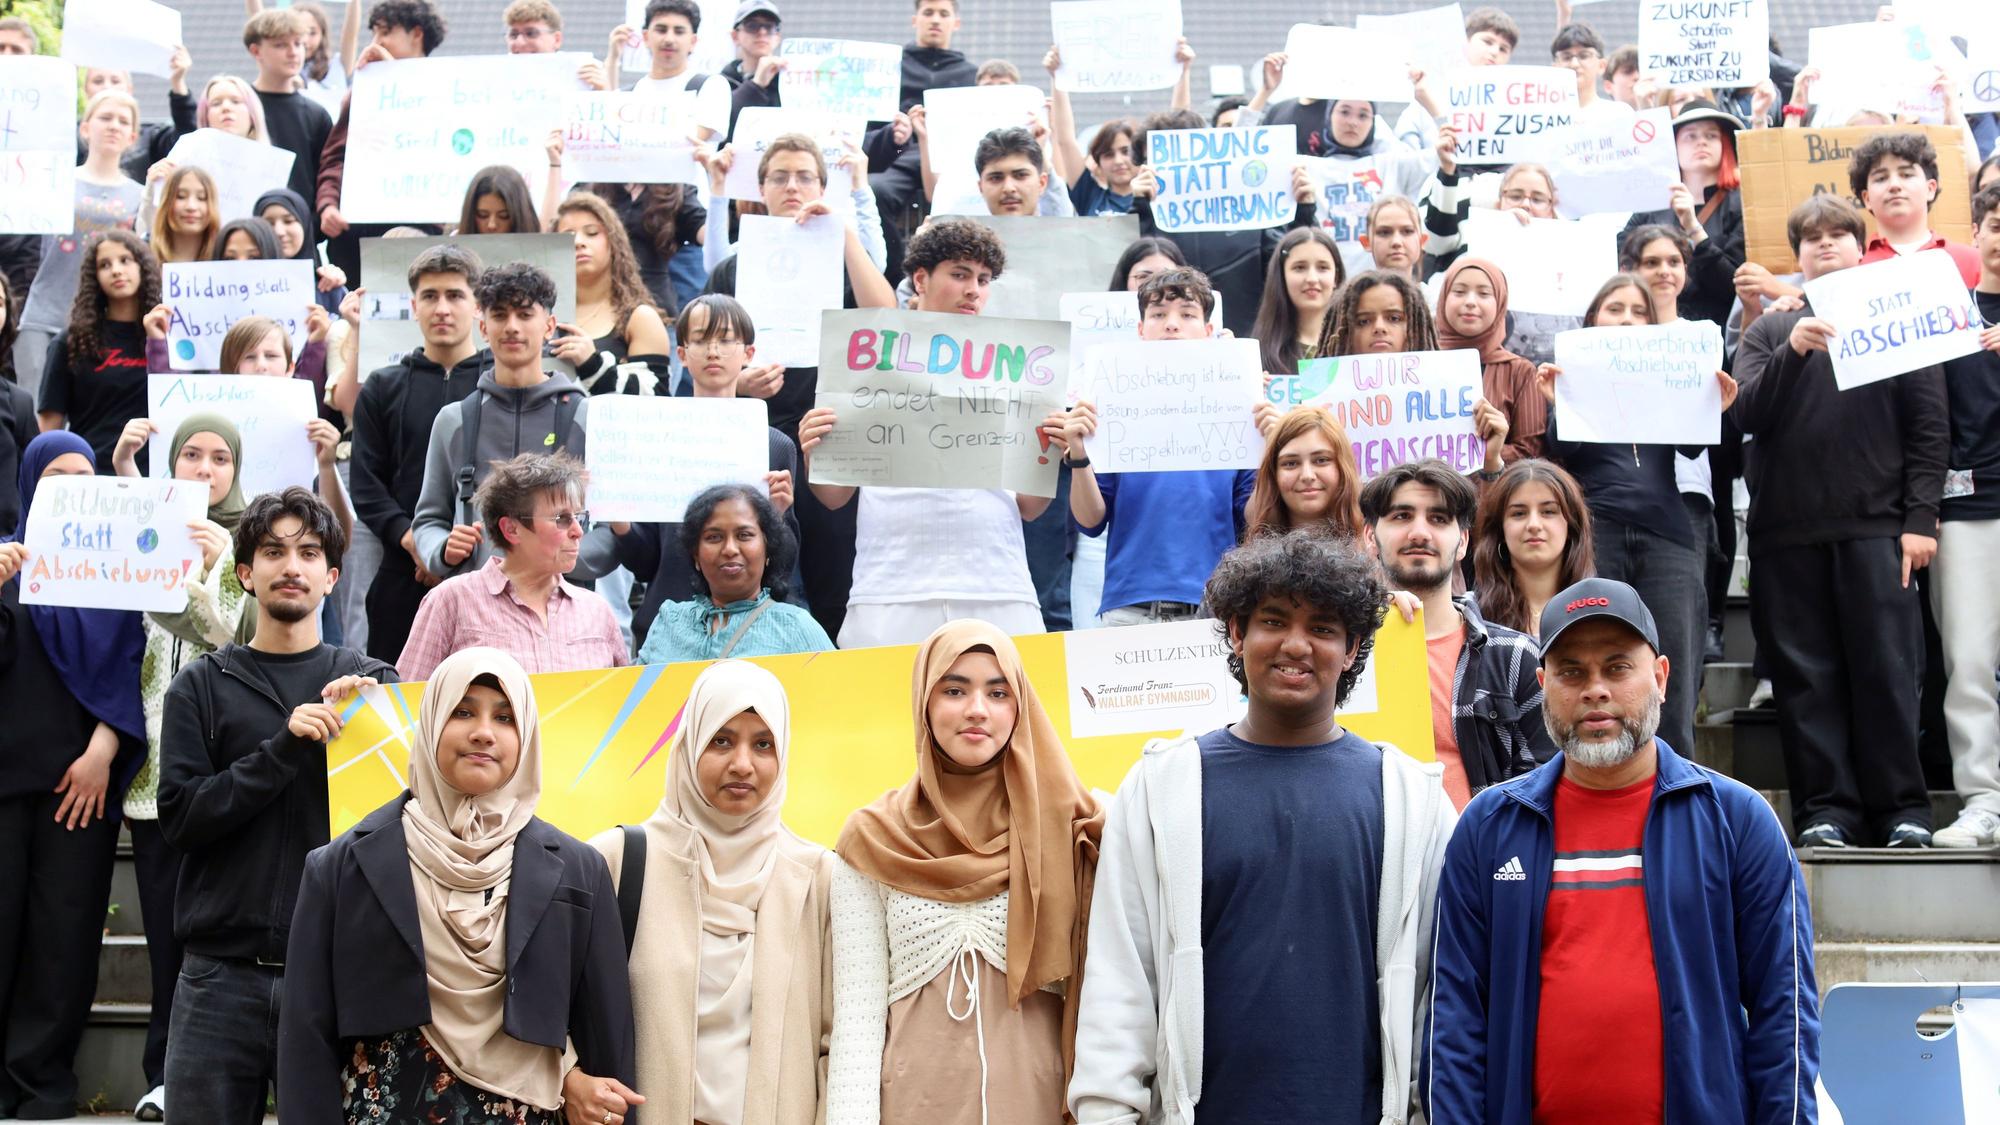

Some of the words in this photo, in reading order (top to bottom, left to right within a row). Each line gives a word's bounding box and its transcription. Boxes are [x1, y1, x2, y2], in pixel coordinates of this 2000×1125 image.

[1652, 1, 1752, 20] ZUKUNFT
[1649, 52, 1713, 69] ZUKUNFT
[1720, 51, 1741, 66] ZU
[1450, 83, 1496, 106] WIR
[1151, 130, 1270, 164] BILDUNG
[1454, 139, 1505, 157] MEN
[1155, 161, 1232, 196] STATT
[1156, 191, 1290, 229] ABSCHIEBUNG
[170, 272, 249, 301] Bildung
[1869, 291, 1912, 318] STATT
[847, 328, 1056, 386] BILDUNG
[1090, 356, 1197, 394] Abschiebung
[1202, 366, 1215, 383] ist
[1352, 355, 1421, 391] WIR
[852, 383, 940, 412] endet
[957, 385, 1042, 419] NICHT
[1405, 385, 1475, 424] ALLE
[866, 423, 905, 446] an
[928, 423, 1027, 450] Grenzen
[61, 521, 114, 549] Statt
[1565, 596, 1609, 612] HUGO
[1113, 643, 1229, 666] SCHULZENTRU
[1097, 683, 1144, 695] Ferdinand
[1145, 680, 1173, 691] Franz
[1098, 693, 1145, 709] WALLRAF
[1147, 688, 1212, 705] GYMNASIUM
[1493, 872, 1527, 881] adidas
